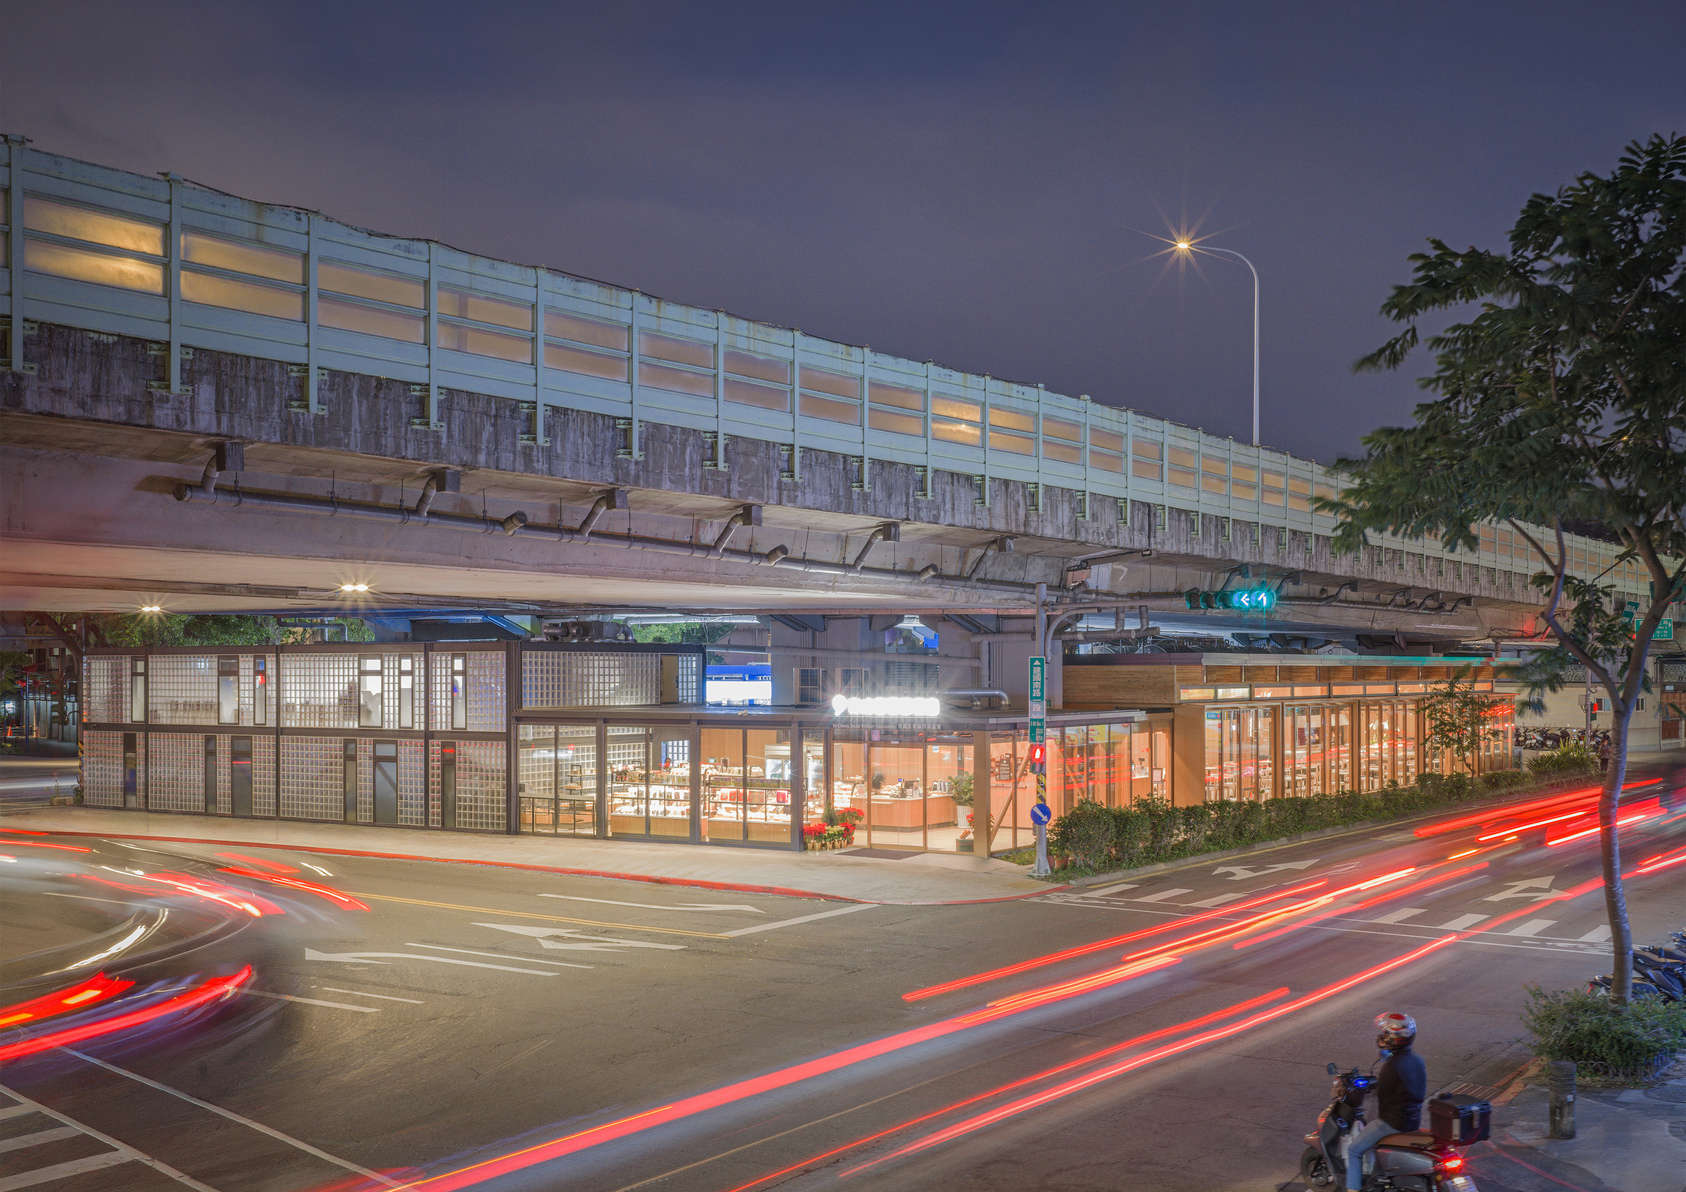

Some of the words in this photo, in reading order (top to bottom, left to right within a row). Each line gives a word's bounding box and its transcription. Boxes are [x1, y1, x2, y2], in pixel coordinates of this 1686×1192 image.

[1032, 666, 1042, 712] 建國南路一段
